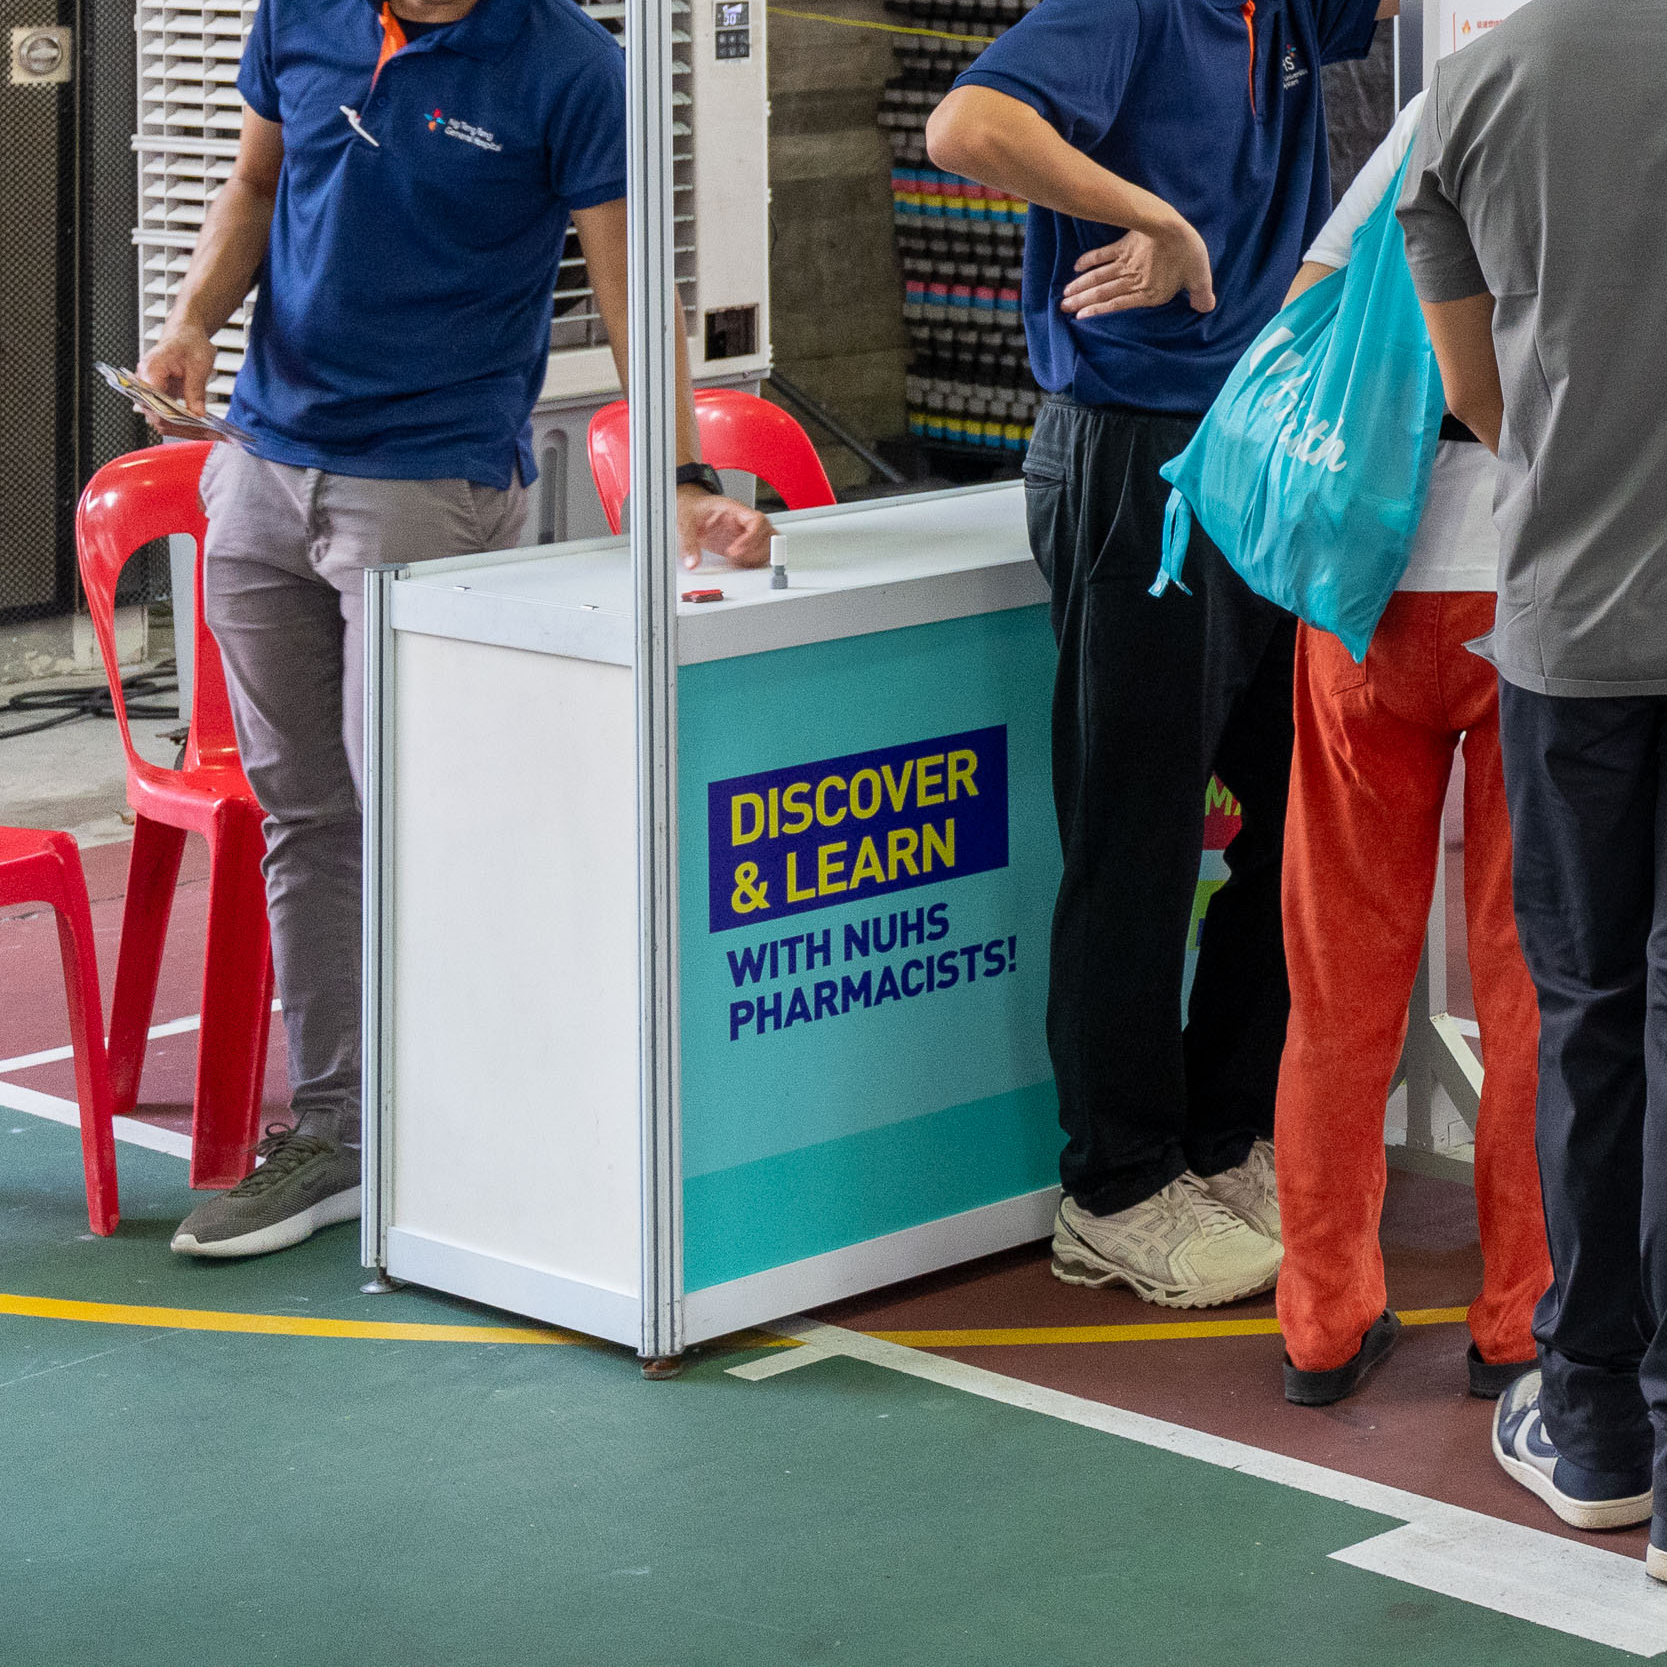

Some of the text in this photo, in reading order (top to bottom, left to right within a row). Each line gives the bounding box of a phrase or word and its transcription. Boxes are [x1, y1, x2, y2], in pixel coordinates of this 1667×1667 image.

[731, 748, 980, 847] DISCOVER
[731, 818, 956, 914] & LEARN
[727, 902, 949, 988] WITH NUHS
[729, 935, 1018, 1042] PHARMACISTS!
